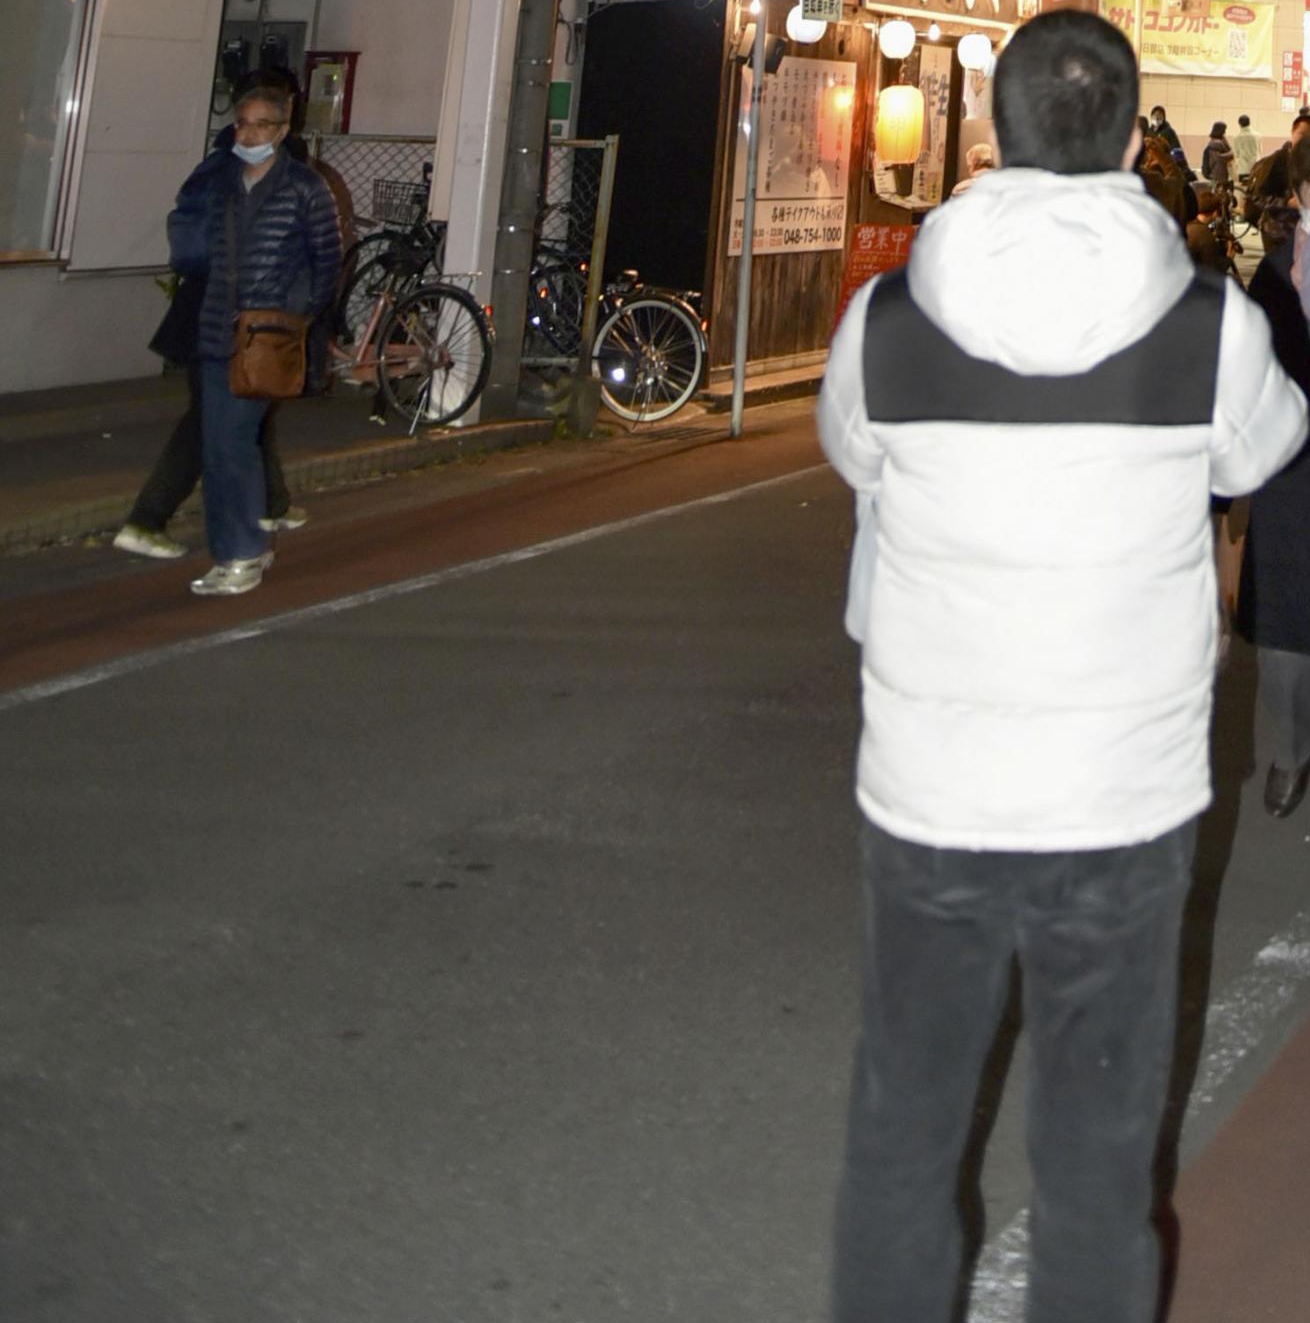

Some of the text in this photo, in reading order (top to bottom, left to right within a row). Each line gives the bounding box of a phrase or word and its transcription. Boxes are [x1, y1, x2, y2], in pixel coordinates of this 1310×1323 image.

[783, 226, 842, 245] 048-754-1000
[858, 226, 907, 256] 営業中
